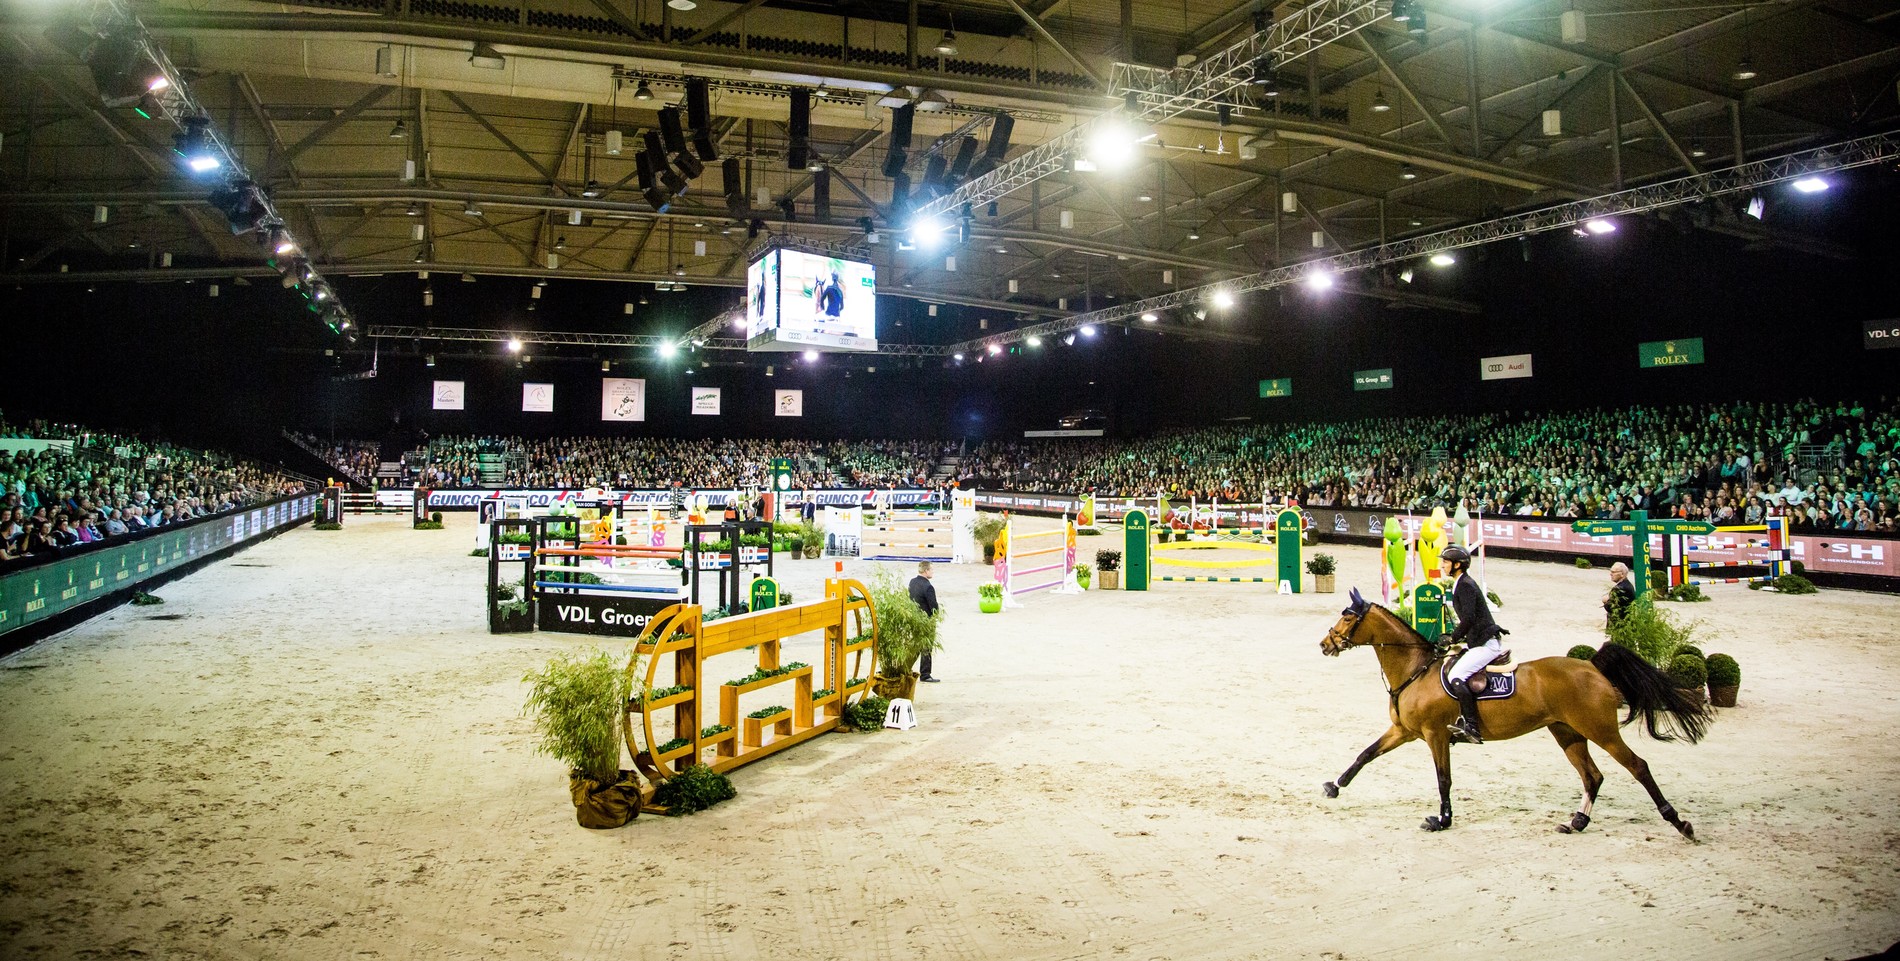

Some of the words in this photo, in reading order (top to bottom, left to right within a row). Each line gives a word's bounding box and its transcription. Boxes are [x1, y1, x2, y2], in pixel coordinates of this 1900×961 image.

[1868, 330, 1889, 338] VDL
[1654, 354, 1689, 365] ROLEX
[1266, 389, 1284, 397] ROLEX
[430, 494, 481, 505] GUNCO
[816, 494, 859, 504] GUNCO
[1484, 523, 1514, 537] SH
[1529, 526, 1562, 540] SH
[497, 543, 522, 560] VDL
[738, 546, 761, 563] VDL
[1831, 543, 1884, 560] SH
[698, 551, 723, 569] VDL
[90, 577, 104, 590] ROLEX
[62, 586, 78, 600] ROLEX
[26, 597, 46, 613] ROLEX
[557, 605, 595, 623] VDL
[891, 705, 901, 724] 11
